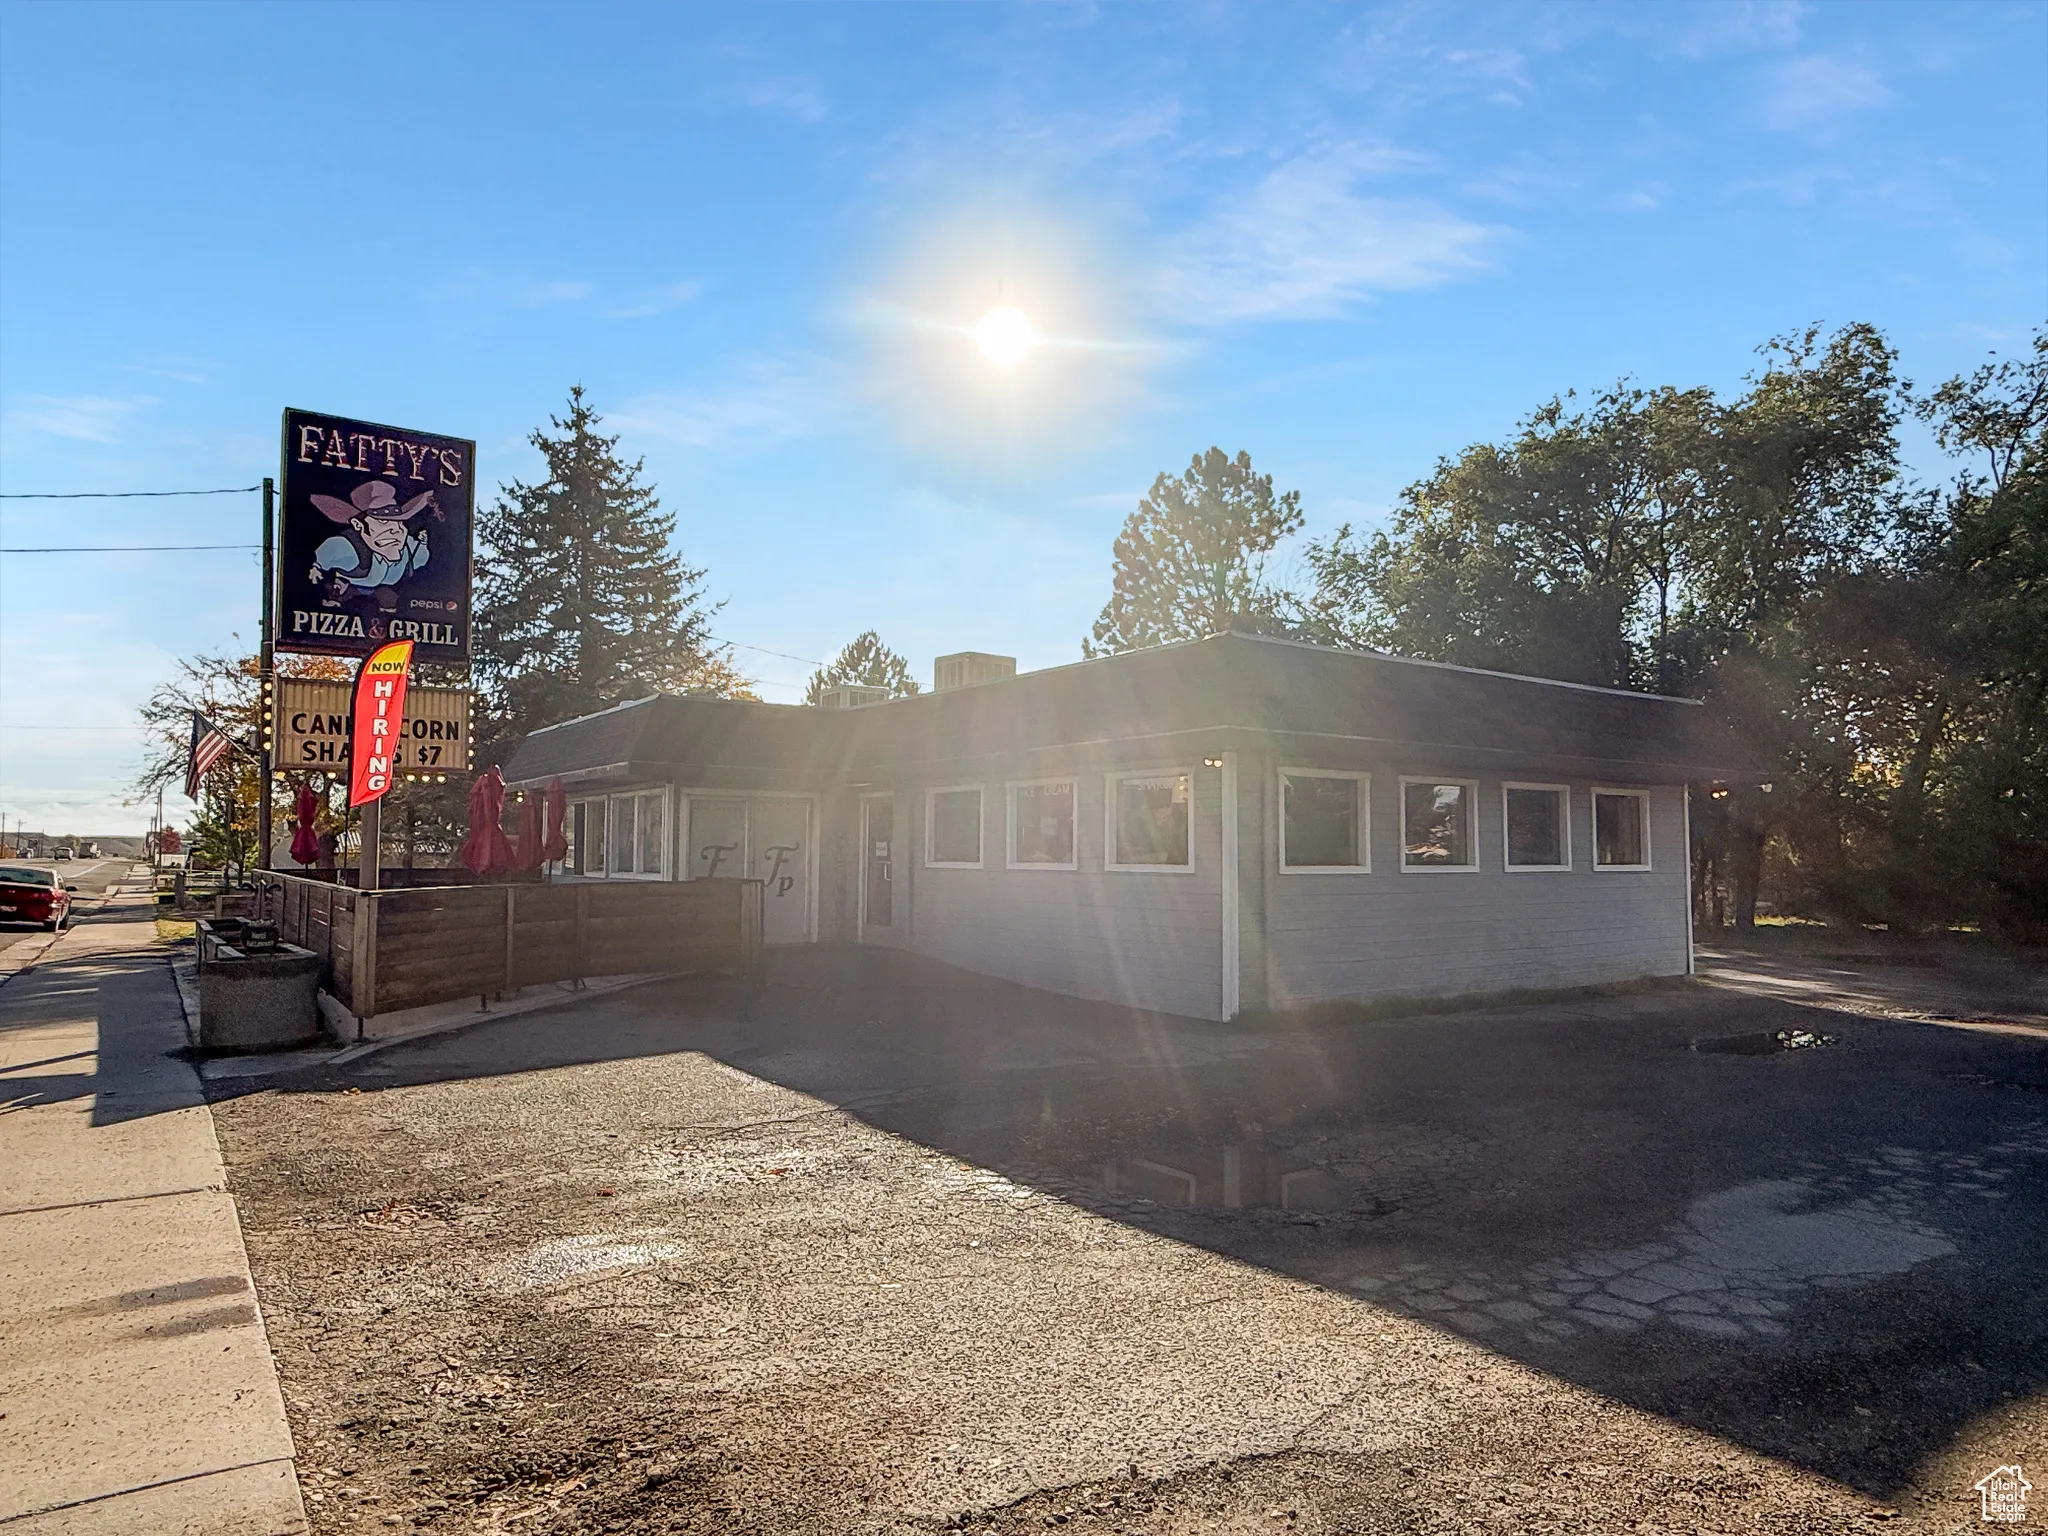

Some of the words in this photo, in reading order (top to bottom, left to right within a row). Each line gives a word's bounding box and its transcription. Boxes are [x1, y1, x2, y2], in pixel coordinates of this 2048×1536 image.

[298, 424, 462, 486] FATTY'S
[410, 599, 443, 610] pepsi
[293, 610, 366, 638] PIZZA
[368, 618, 387, 640] &
[389, 620, 459, 646] GRILL
[371, 662, 406, 673] NOW
[367, 680, 393, 791] HIRING
[418, 746, 443, 766] $7
